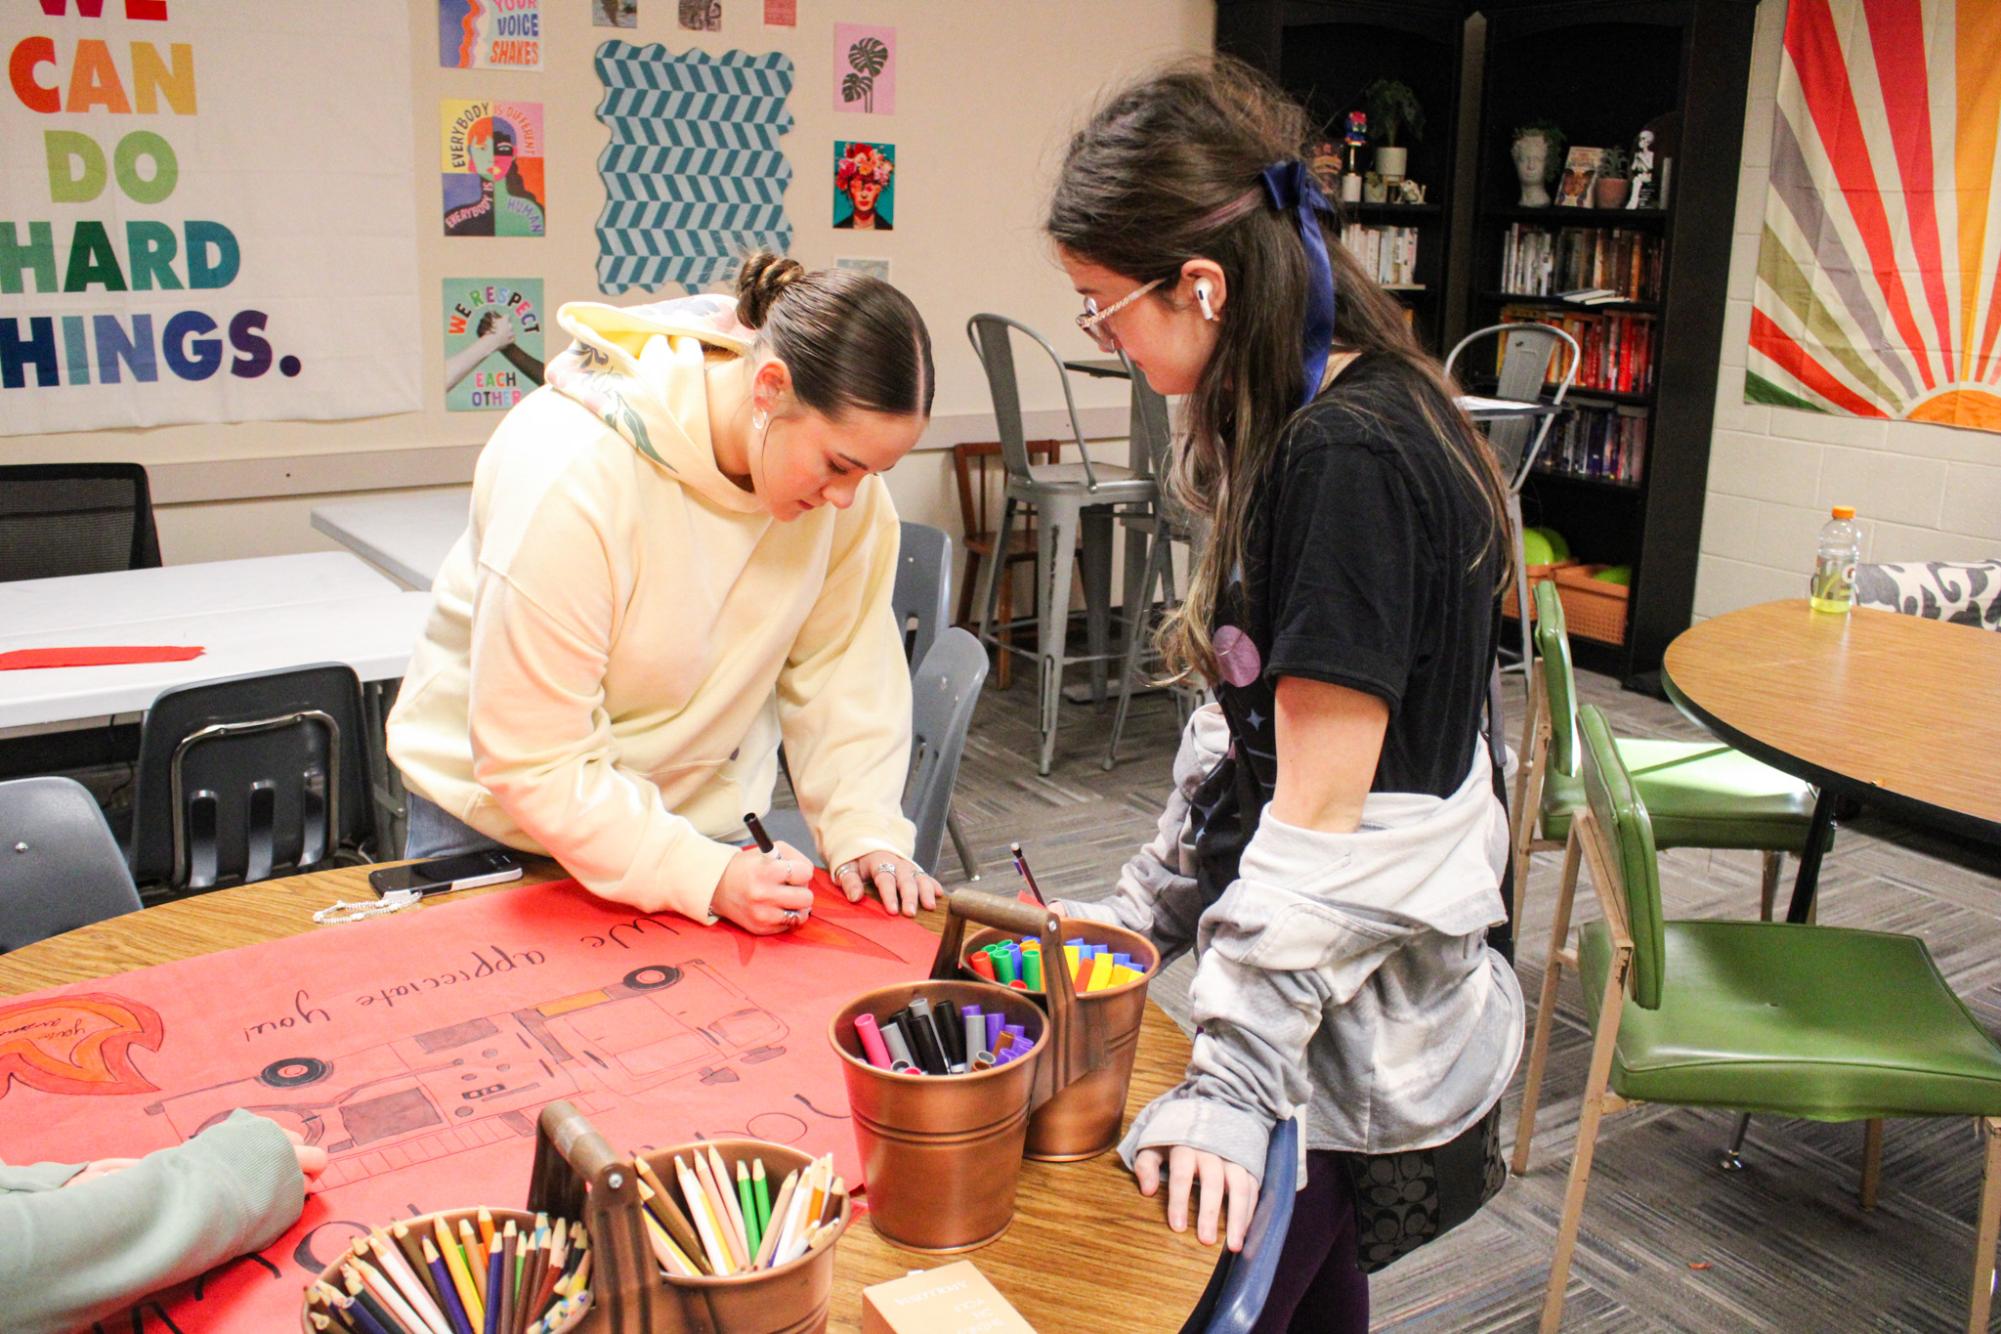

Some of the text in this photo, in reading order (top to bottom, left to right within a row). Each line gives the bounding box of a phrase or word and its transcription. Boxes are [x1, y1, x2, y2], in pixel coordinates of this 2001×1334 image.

[497, 13, 539, 37] VOICE
[9, 36, 197, 116] CAN
[489, 40, 539, 65] SHAKES
[450, 103, 489, 168] EVERYBODY
[44, 130, 178, 204] DO
[445, 194, 493, 228] EVERYBODY
[507, 198, 543, 232] HUMAN
[0, 220, 241, 294] HARD
[448, 286, 540, 335] WE RESPECT
[0, 309, 301, 388] HINGS.
[471, 390, 522, 407] OTHER
[475, 371, 517, 388] EACH
[580, 916, 680, 949] We
[356, 944, 546, 1008] appreciate
